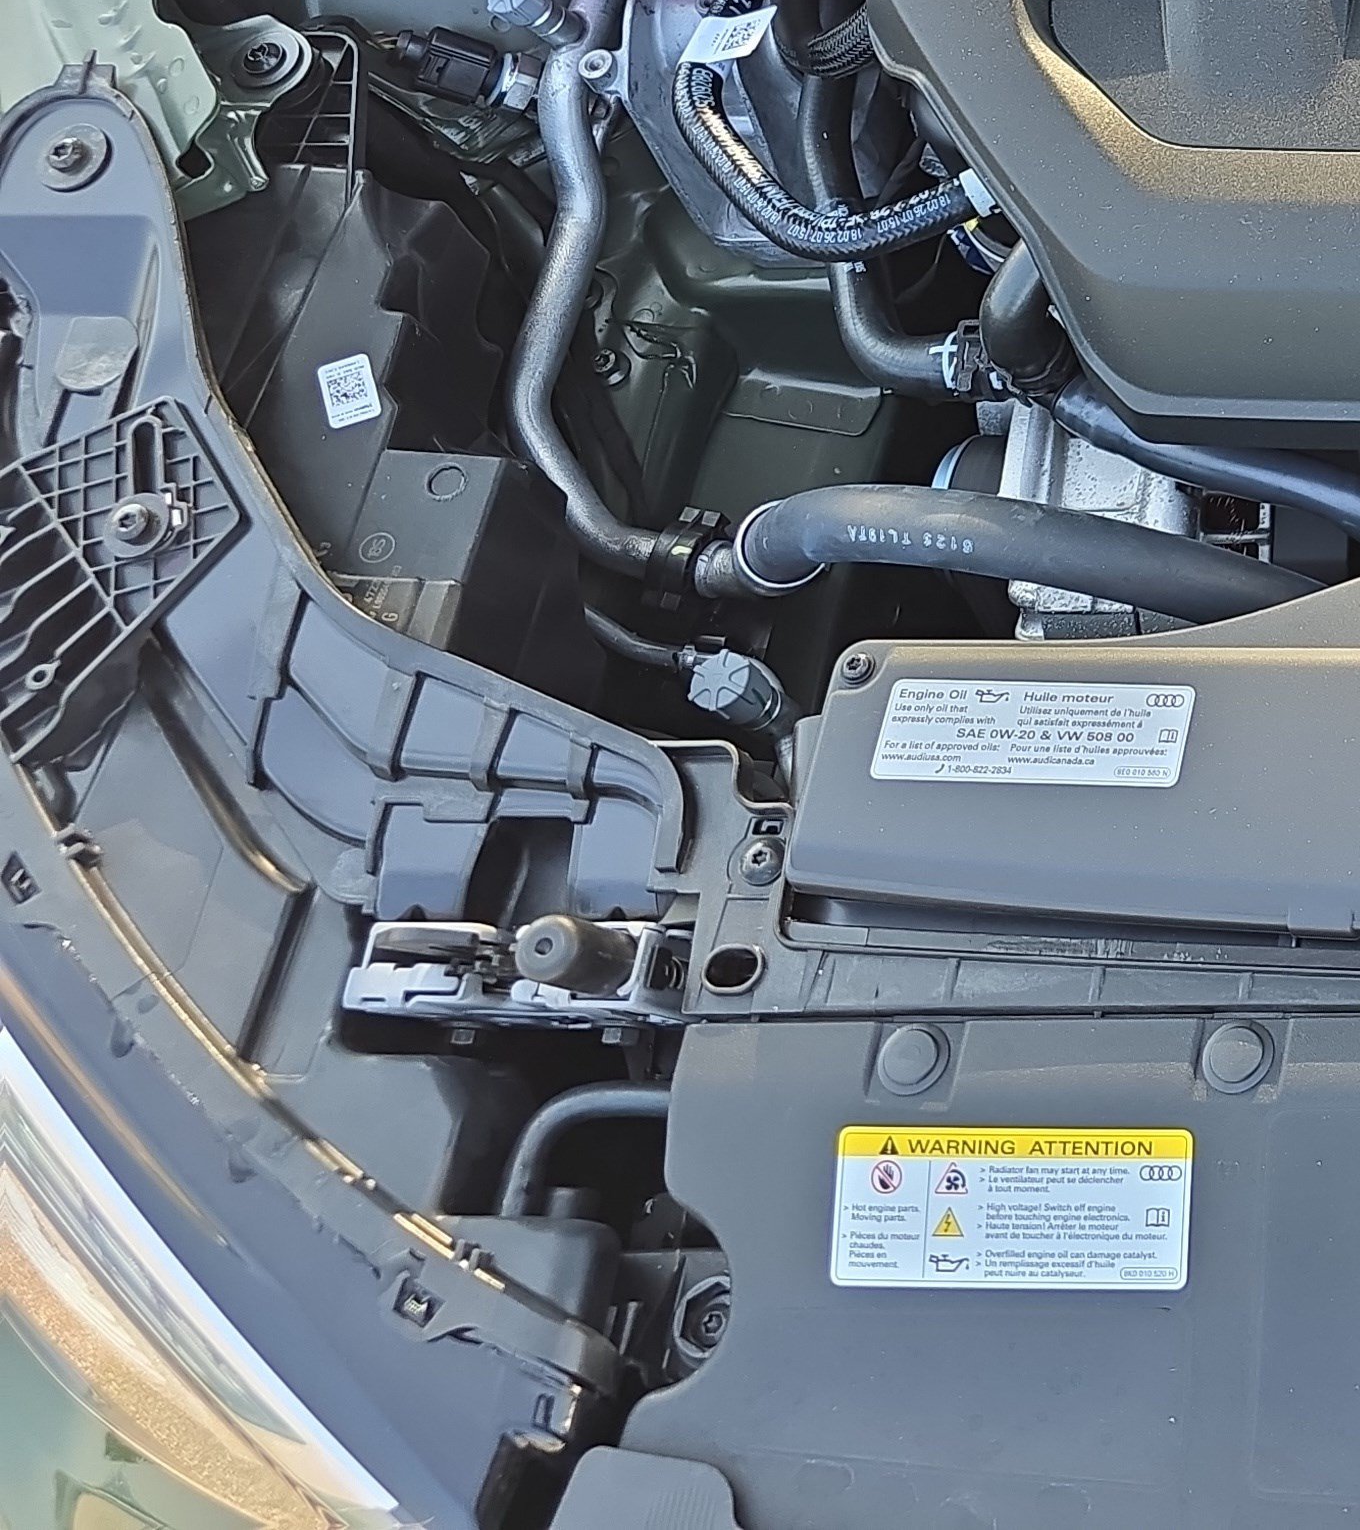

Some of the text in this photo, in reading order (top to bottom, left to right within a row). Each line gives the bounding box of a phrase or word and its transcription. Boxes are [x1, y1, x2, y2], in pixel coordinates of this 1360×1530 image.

[899, 689, 967, 700] Engine Oil
[1024, 692, 1114, 703] Huile moteur
[895, 703, 968, 713] Use only oil that
[1020, 706, 1052, 715] Utilisez
[1054, 707, 1108, 717] uniquement
[1111, 708, 1121, 717] de
[892, 716, 995, 725] expressly complies with
[1017, 718, 1032, 726] qui
[956, 728, 1134, 742] SAE 0W-20 & VW 508 00
[884, 741, 900, 749] For
[909, 741, 923, 749] list
[925, 741, 935, 750] of
[936, 742, 978, 752] approved
[1010, 744, 1032, 752] Pour
[1053, 745, 1072, 753] liste
[881, 752, 961, 762] www.audiusa.com
[1007, 756, 1095, 765] www.audicanada.ca
[908, 1139, 1154, 1156] WARNING ATTENTION
[989, 1166, 1024, 1174] Radiator
[986, 1203, 1007, 1212] High
[1044, 1204, 1072, 1212] Switch
[1087, 1205, 1116, 1214] engine
[851, 1214, 882, 1222] Moving
